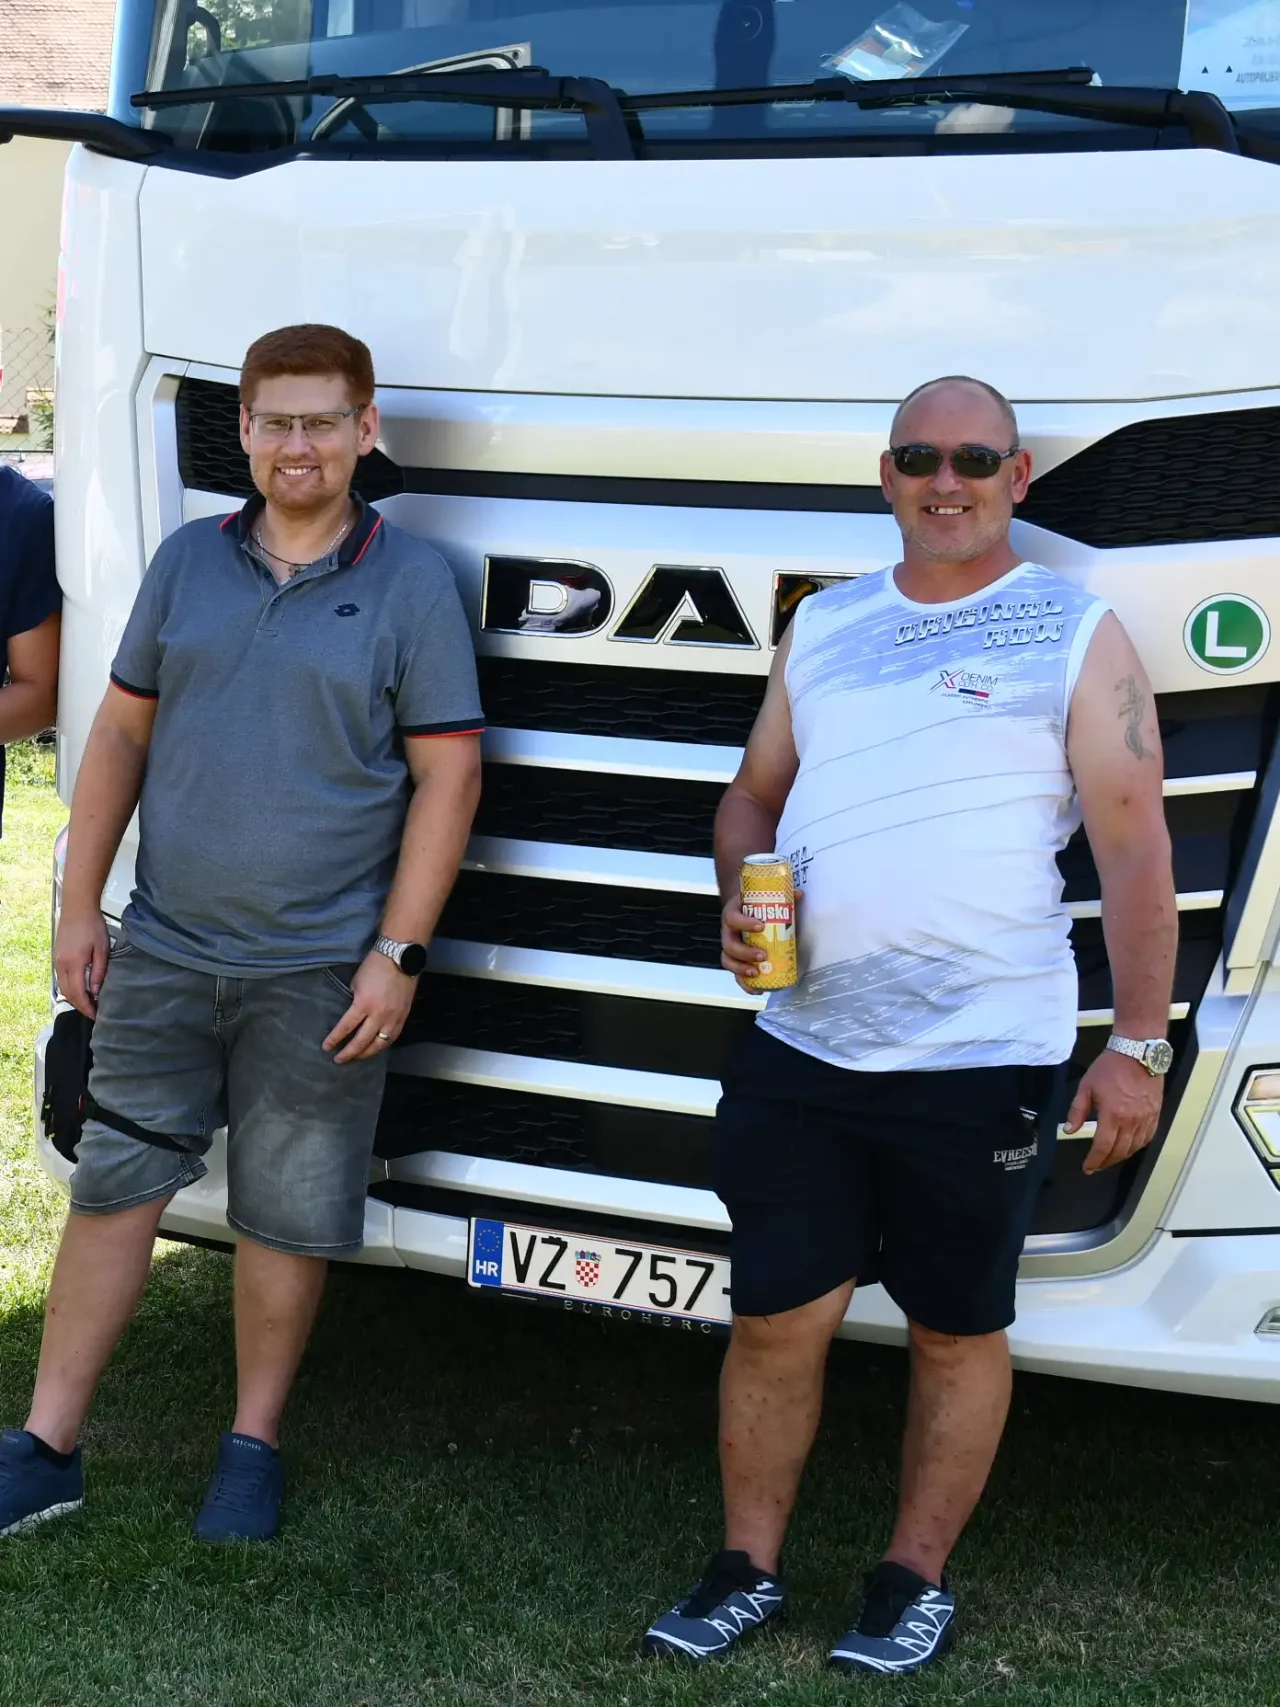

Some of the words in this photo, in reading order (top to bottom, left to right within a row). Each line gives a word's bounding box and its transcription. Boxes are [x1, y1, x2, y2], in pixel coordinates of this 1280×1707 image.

[894, 600, 1064, 646] ORIGINAL
[982, 622, 1064, 650] ROW
[1204, 610, 1248, 658] L
[961, 672, 999, 686] DENIM
[742, 903, 790, 921] Ožujsko
[475, 1259, 499, 1278] HR
[562, 1299, 712, 1334] EUROHERC
